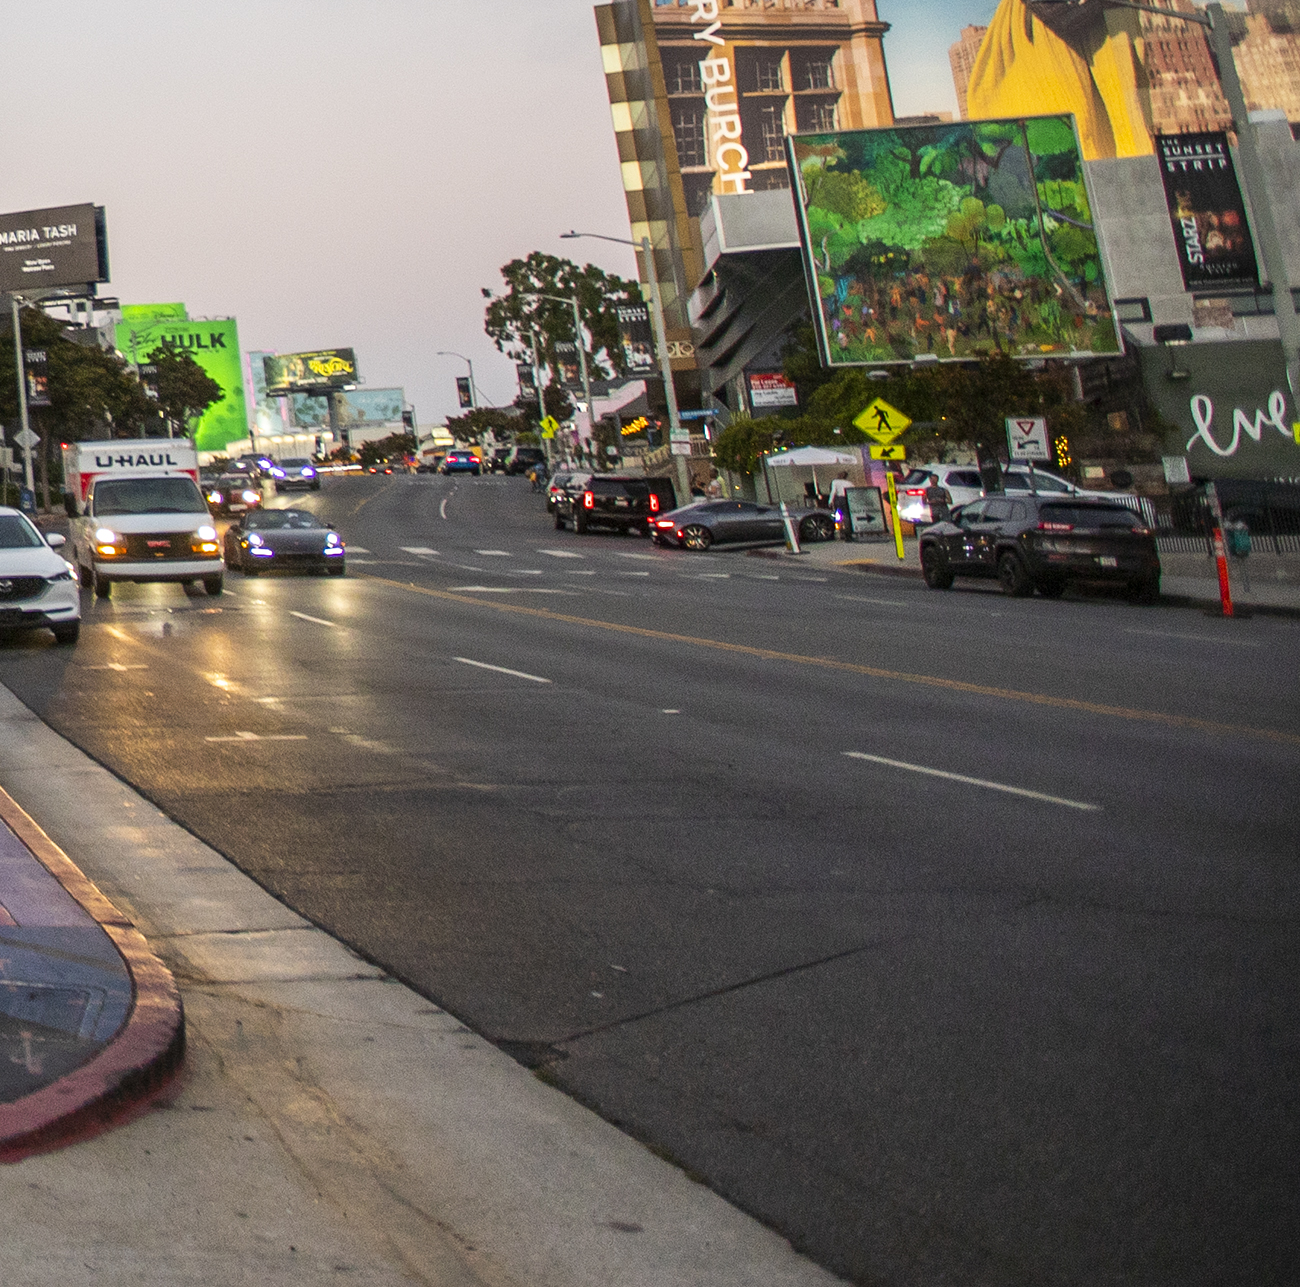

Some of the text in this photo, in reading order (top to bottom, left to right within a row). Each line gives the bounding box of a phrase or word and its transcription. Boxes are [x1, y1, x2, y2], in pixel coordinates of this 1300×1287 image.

[699, 57, 754, 194] BURCH
[1163, 144, 1224, 156] SUNSET
[1167, 159, 1227, 172] STRIP
[42, 223, 77, 239] TASH
[160, 332, 227, 349] HULK
[95, 454, 178, 468] U-HAUL
